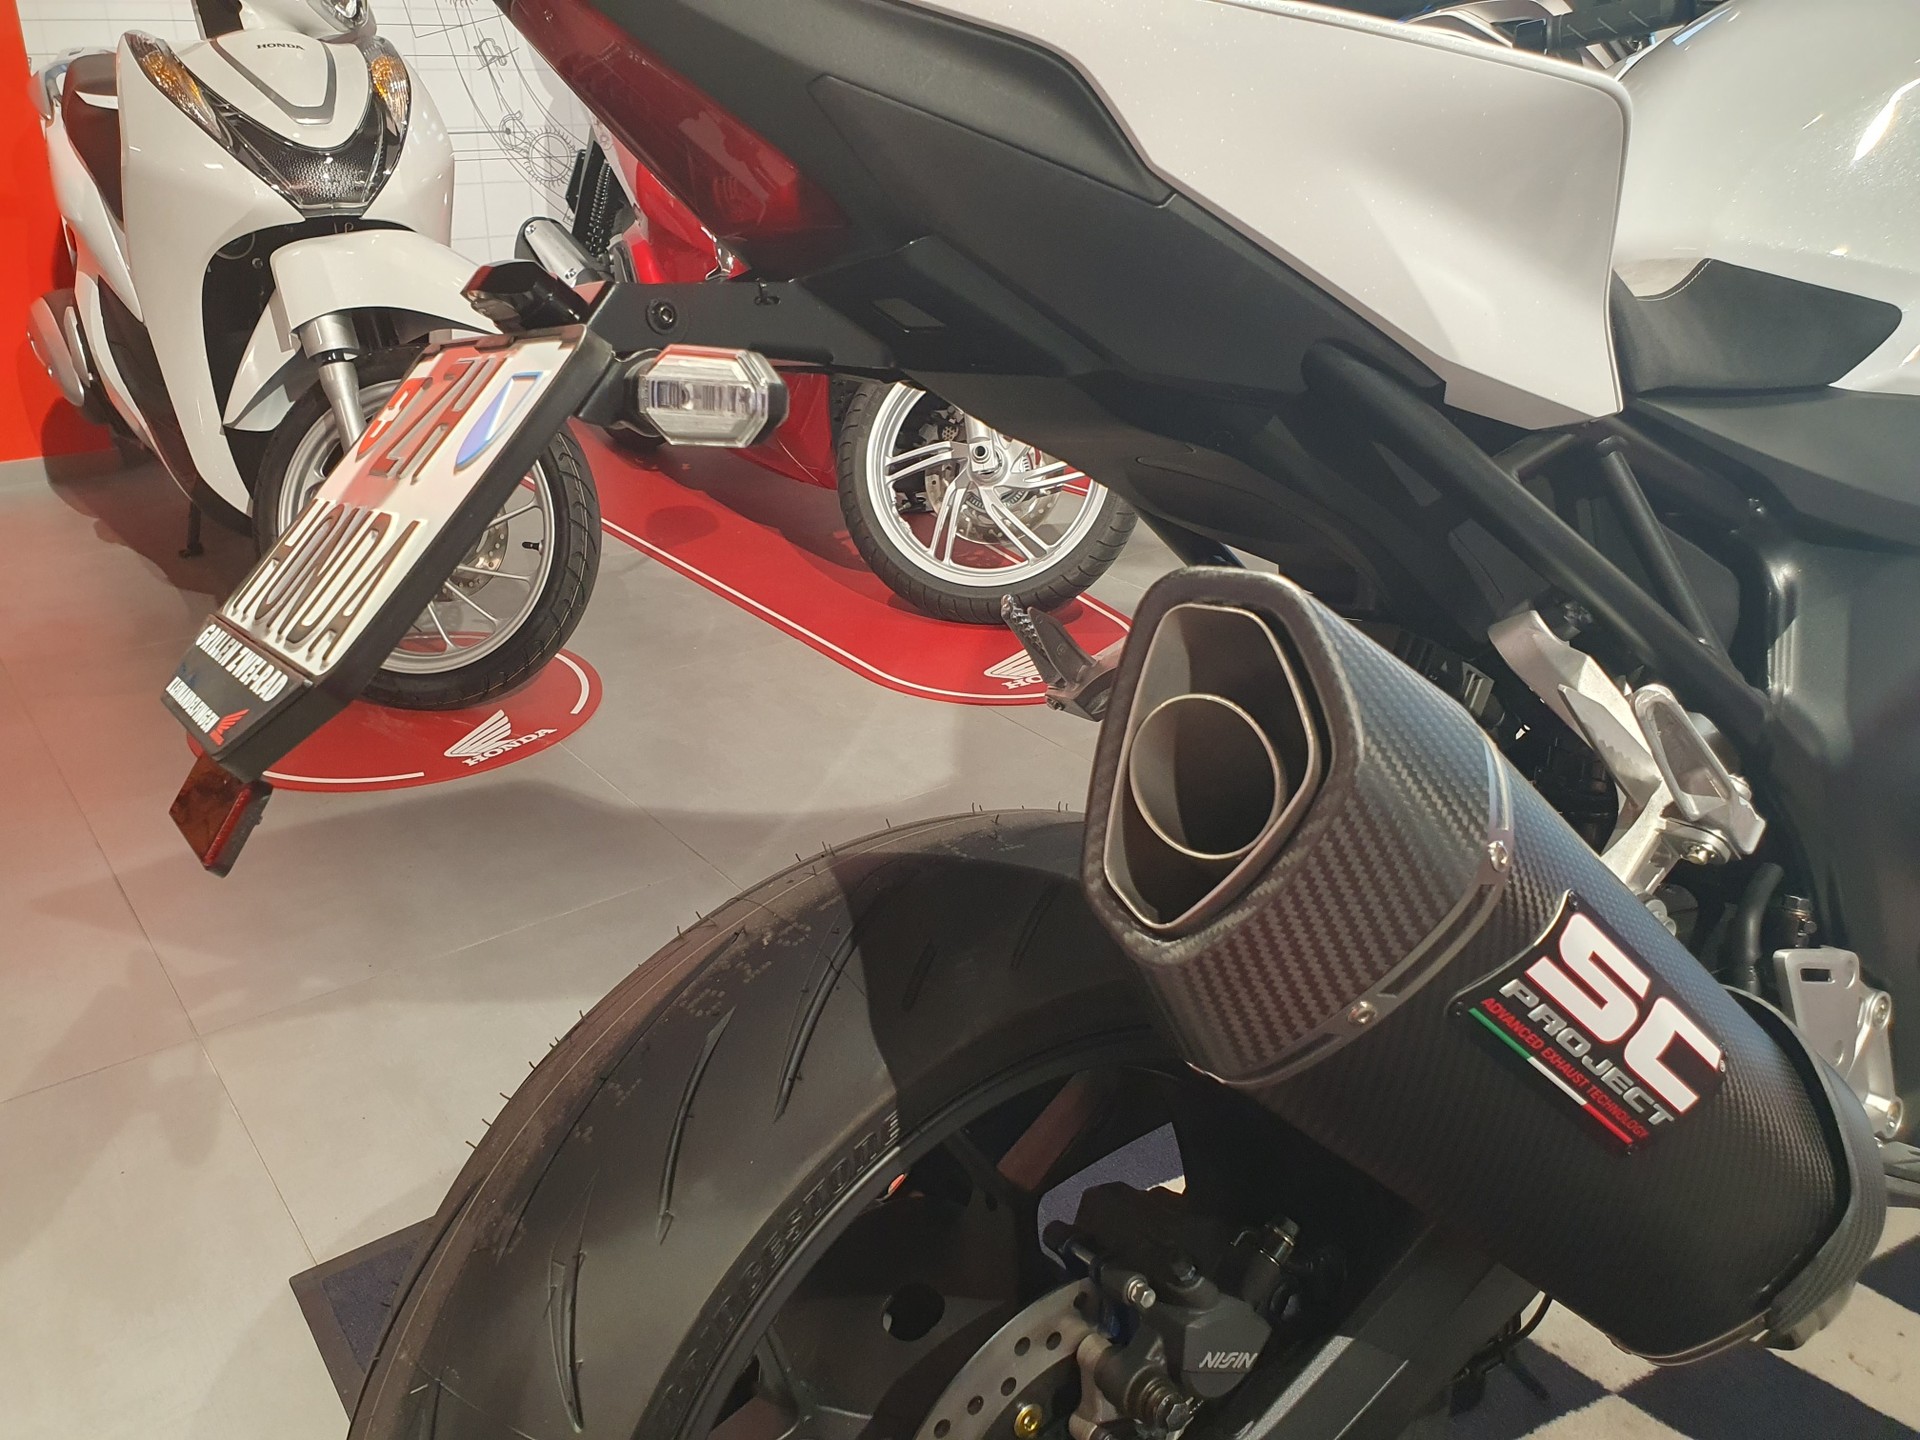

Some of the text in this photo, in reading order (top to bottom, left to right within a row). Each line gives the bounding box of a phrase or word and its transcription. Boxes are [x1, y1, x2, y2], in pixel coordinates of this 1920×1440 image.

[370, 356, 499, 485] ZH
[233, 499, 421, 662] HONDA
[196, 624, 289, 702] GRILLEN ZWEI-RAD
[462, 728, 558, 767] HONDA
[1481, 997, 1649, 1138] ADVANCED EXHAUST TECHNOLOGY
[1499, 979, 1675, 1126] PROJECT
[1524, 912, 1722, 1114] SC
